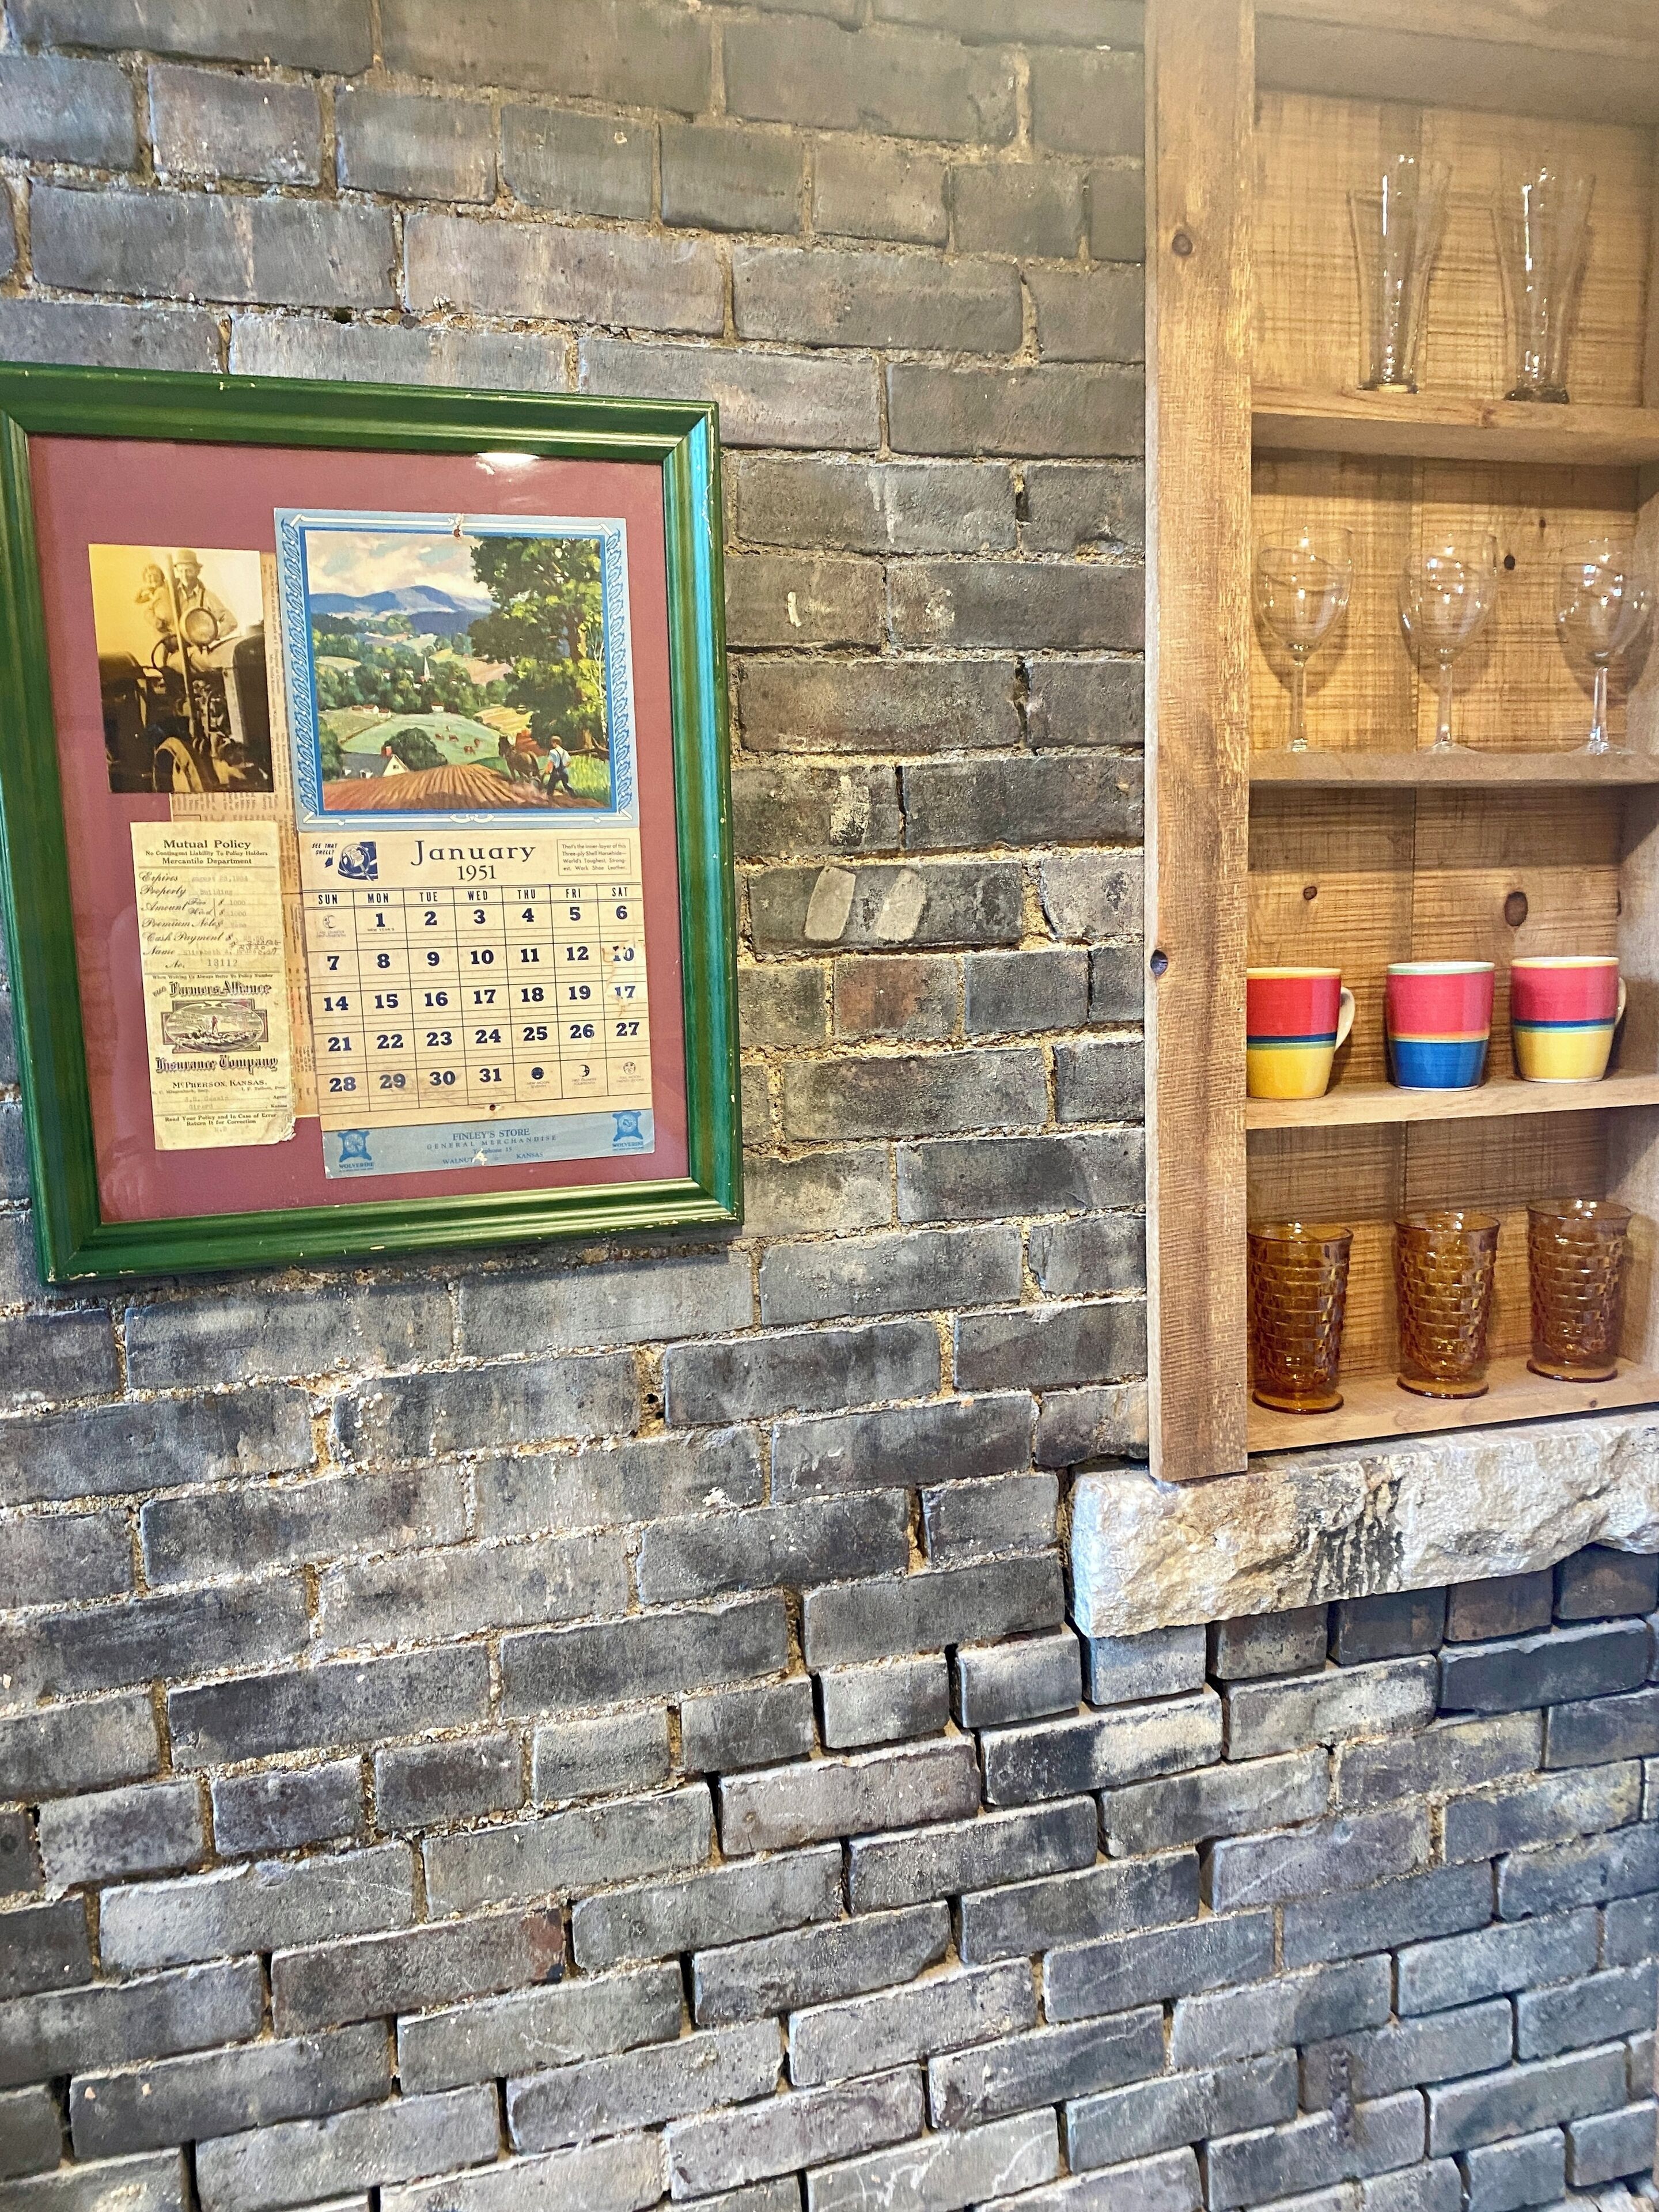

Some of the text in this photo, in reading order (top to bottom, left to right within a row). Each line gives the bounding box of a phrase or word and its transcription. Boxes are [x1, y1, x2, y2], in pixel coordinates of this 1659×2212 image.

[164, 840, 251, 850] Mutual Policy
[411, 840, 536, 866] January
[207, 857, 252, 865] Department
[139, 872, 178, 884] Expires
[457, 865, 497, 880] 1951
[139, 885, 187, 896] Property
[318, 887, 628, 905] SUN MON TUE WED THU FRI SAT
[141, 900, 187, 911] Amount
[142, 918, 190, 928] Premium
[376, 906, 627, 927] 1 2 3 4 5 6
[142, 932, 171, 941] Cash
[174, 931, 224, 944] Payment
[143, 945, 175, 955] Name
[327, 956, 339, 971] 7
[377, 954, 391, 969] 8
[427, 952, 440, 966] 9
[471, 949, 494, 965] 10
[520, 948, 540, 963] 11
[566, 946, 589, 962] 12
[169, 981, 221, 998] Farmers
[222, 980, 272, 997] Alliance
[324, 985, 636, 1012] 14 15 16 17 18 19 17
[328, 1021, 639, 1052] 21 22 23 24 25 26 27
[155, 1054, 278, 1075] Insurance Company
[329, 1069, 502, 1092] 28 29 30 31
[453, 1128, 530, 1141] FINLEY'S STORE
[427, 1135, 556, 1150] GENERAL MERCHANDISE
